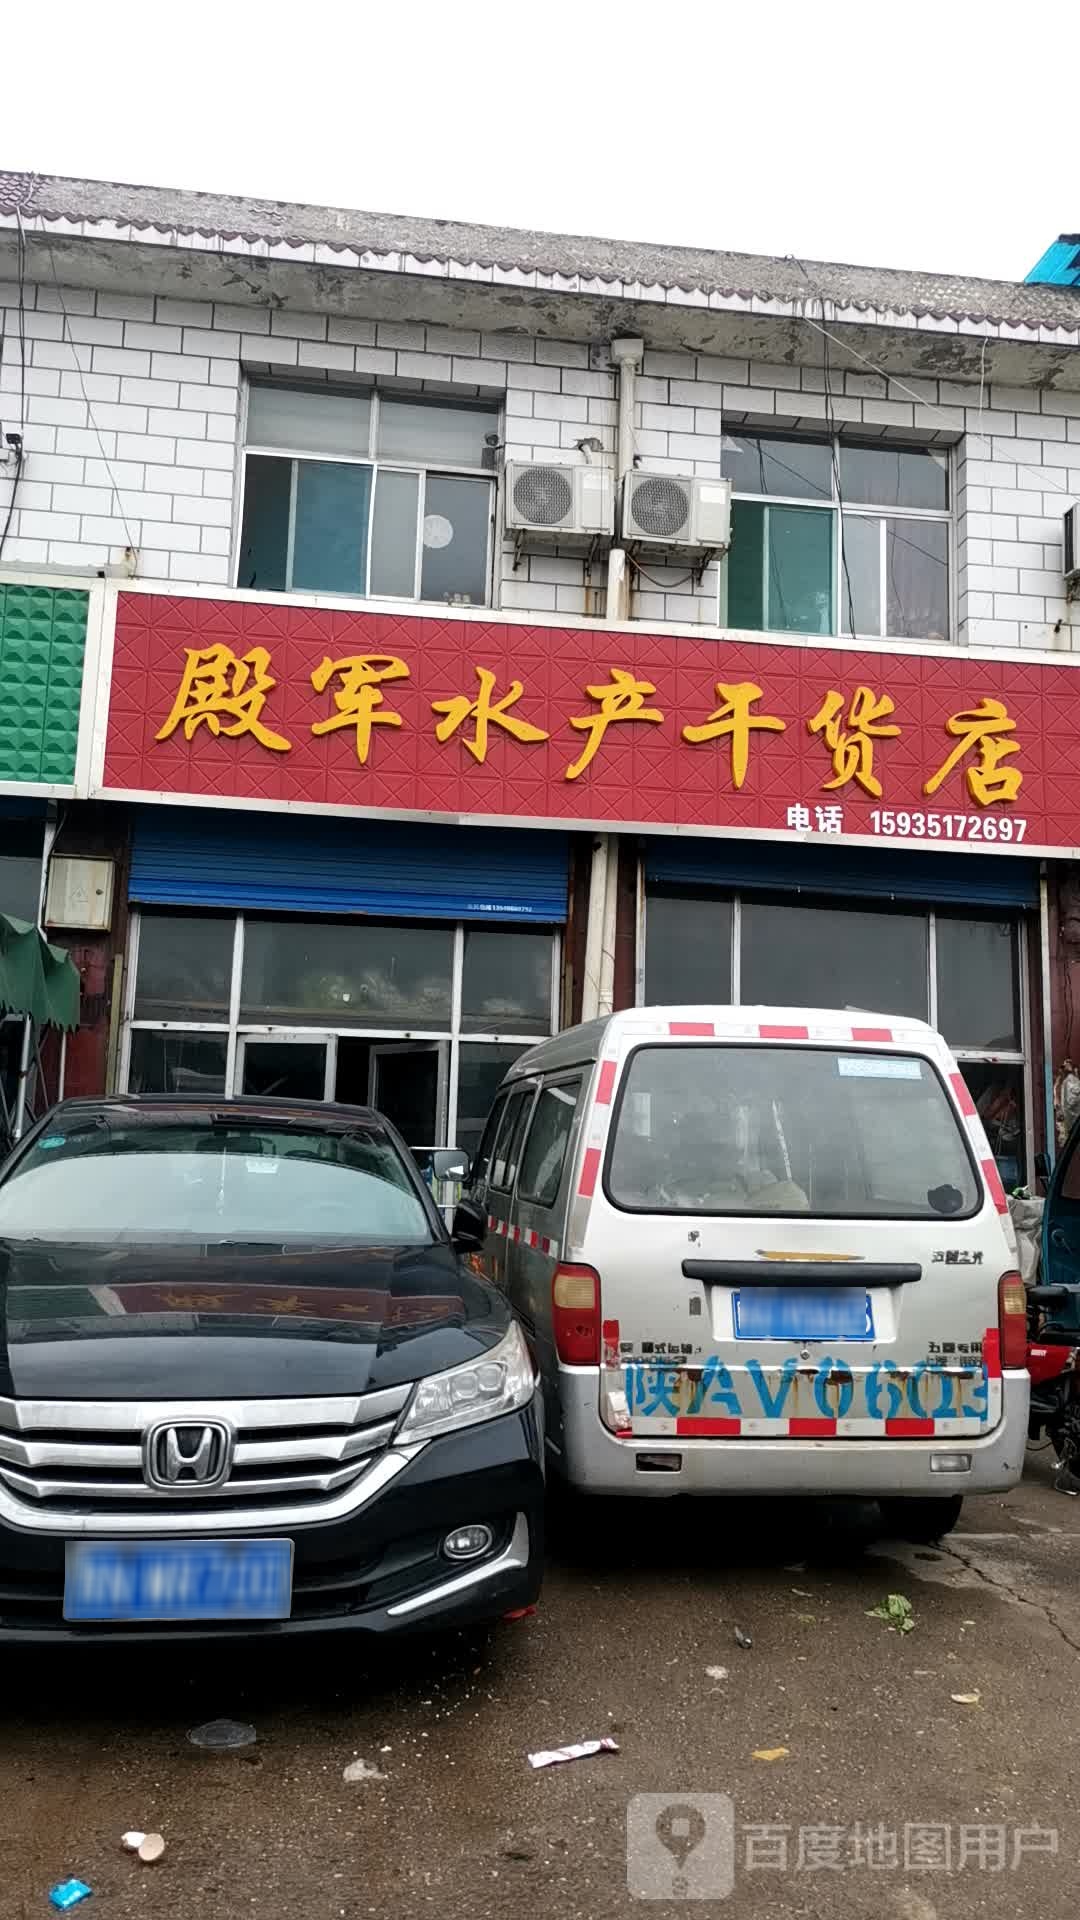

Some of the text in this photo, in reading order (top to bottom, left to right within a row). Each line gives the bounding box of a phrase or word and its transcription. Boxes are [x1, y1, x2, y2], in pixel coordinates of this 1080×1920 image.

[154, 643, 1023, 805] 殿军水产干货店
[786, 803, 1027, 842] 电话 15935172697
